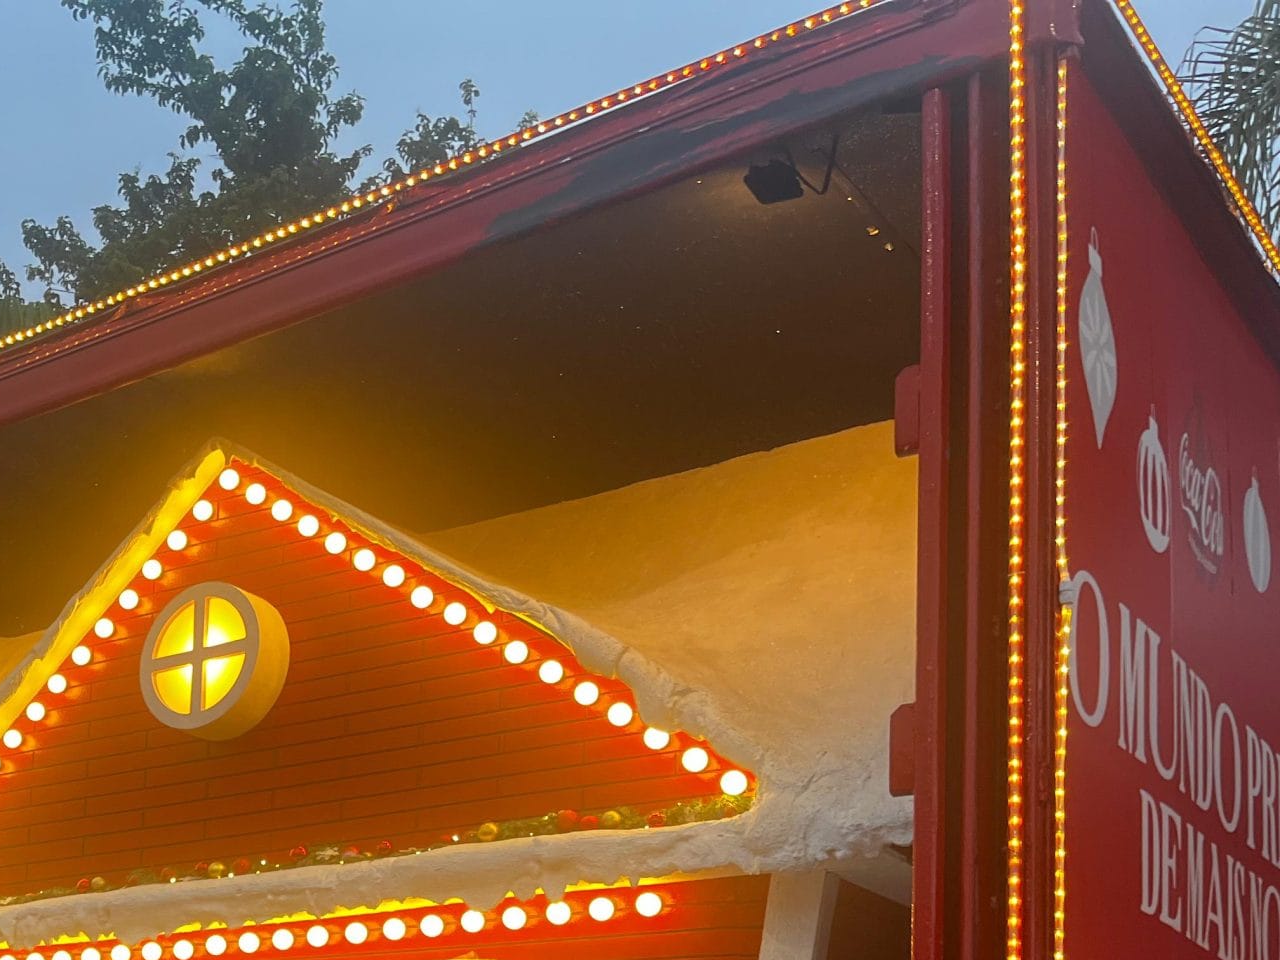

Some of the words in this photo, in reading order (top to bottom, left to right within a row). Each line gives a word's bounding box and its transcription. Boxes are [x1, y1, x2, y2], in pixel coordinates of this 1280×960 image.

[1067, 570, 1110, 727] O
[1117, 602, 1242, 833] MUNDO
[1245, 724, 1280, 870] PR
[1139, 788, 1183, 933] DE
